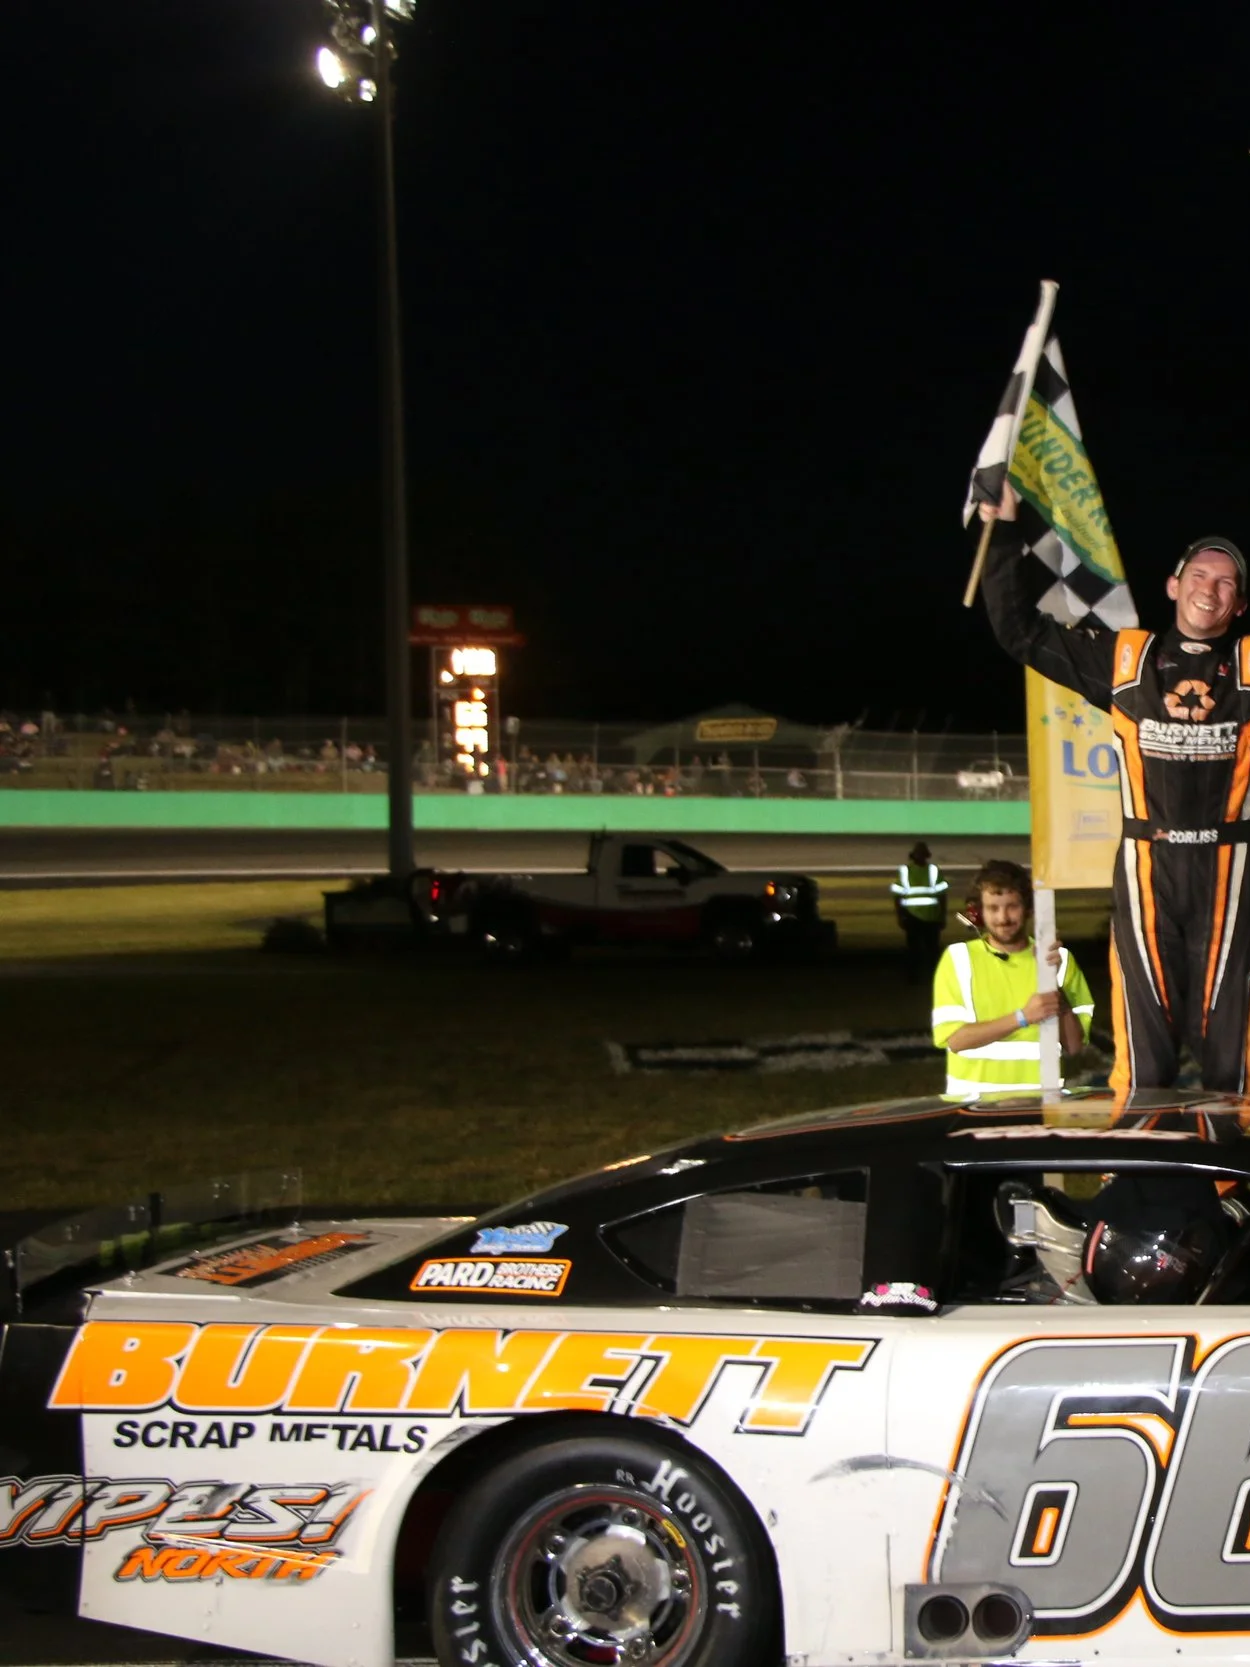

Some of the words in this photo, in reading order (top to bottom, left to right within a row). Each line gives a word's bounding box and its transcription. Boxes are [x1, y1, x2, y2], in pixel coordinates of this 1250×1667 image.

[1139, 718, 1238, 737] BURNETT
[1140, 731, 1184, 745] SCRAP
[1185, 733, 1237, 745] METALS
[1214, 743, 1236, 753] LLC
[1168, 829, 1218, 844] CORLISS
[418, 1262, 495, 1287] PARD
[496, 1262, 565, 1276] BROTHERS
[488, 1274, 558, 1290] RACING
[47, 1320, 880, 1435] BURNETT
[113, 1421, 255, 1449] SCRAP
[269, 1422, 428, 1454] METALS
[615, 1468, 635, 1486] RR
[641, 1459, 742, 1619] Hoosier
[115, 1547, 343, 1582] NORTH
